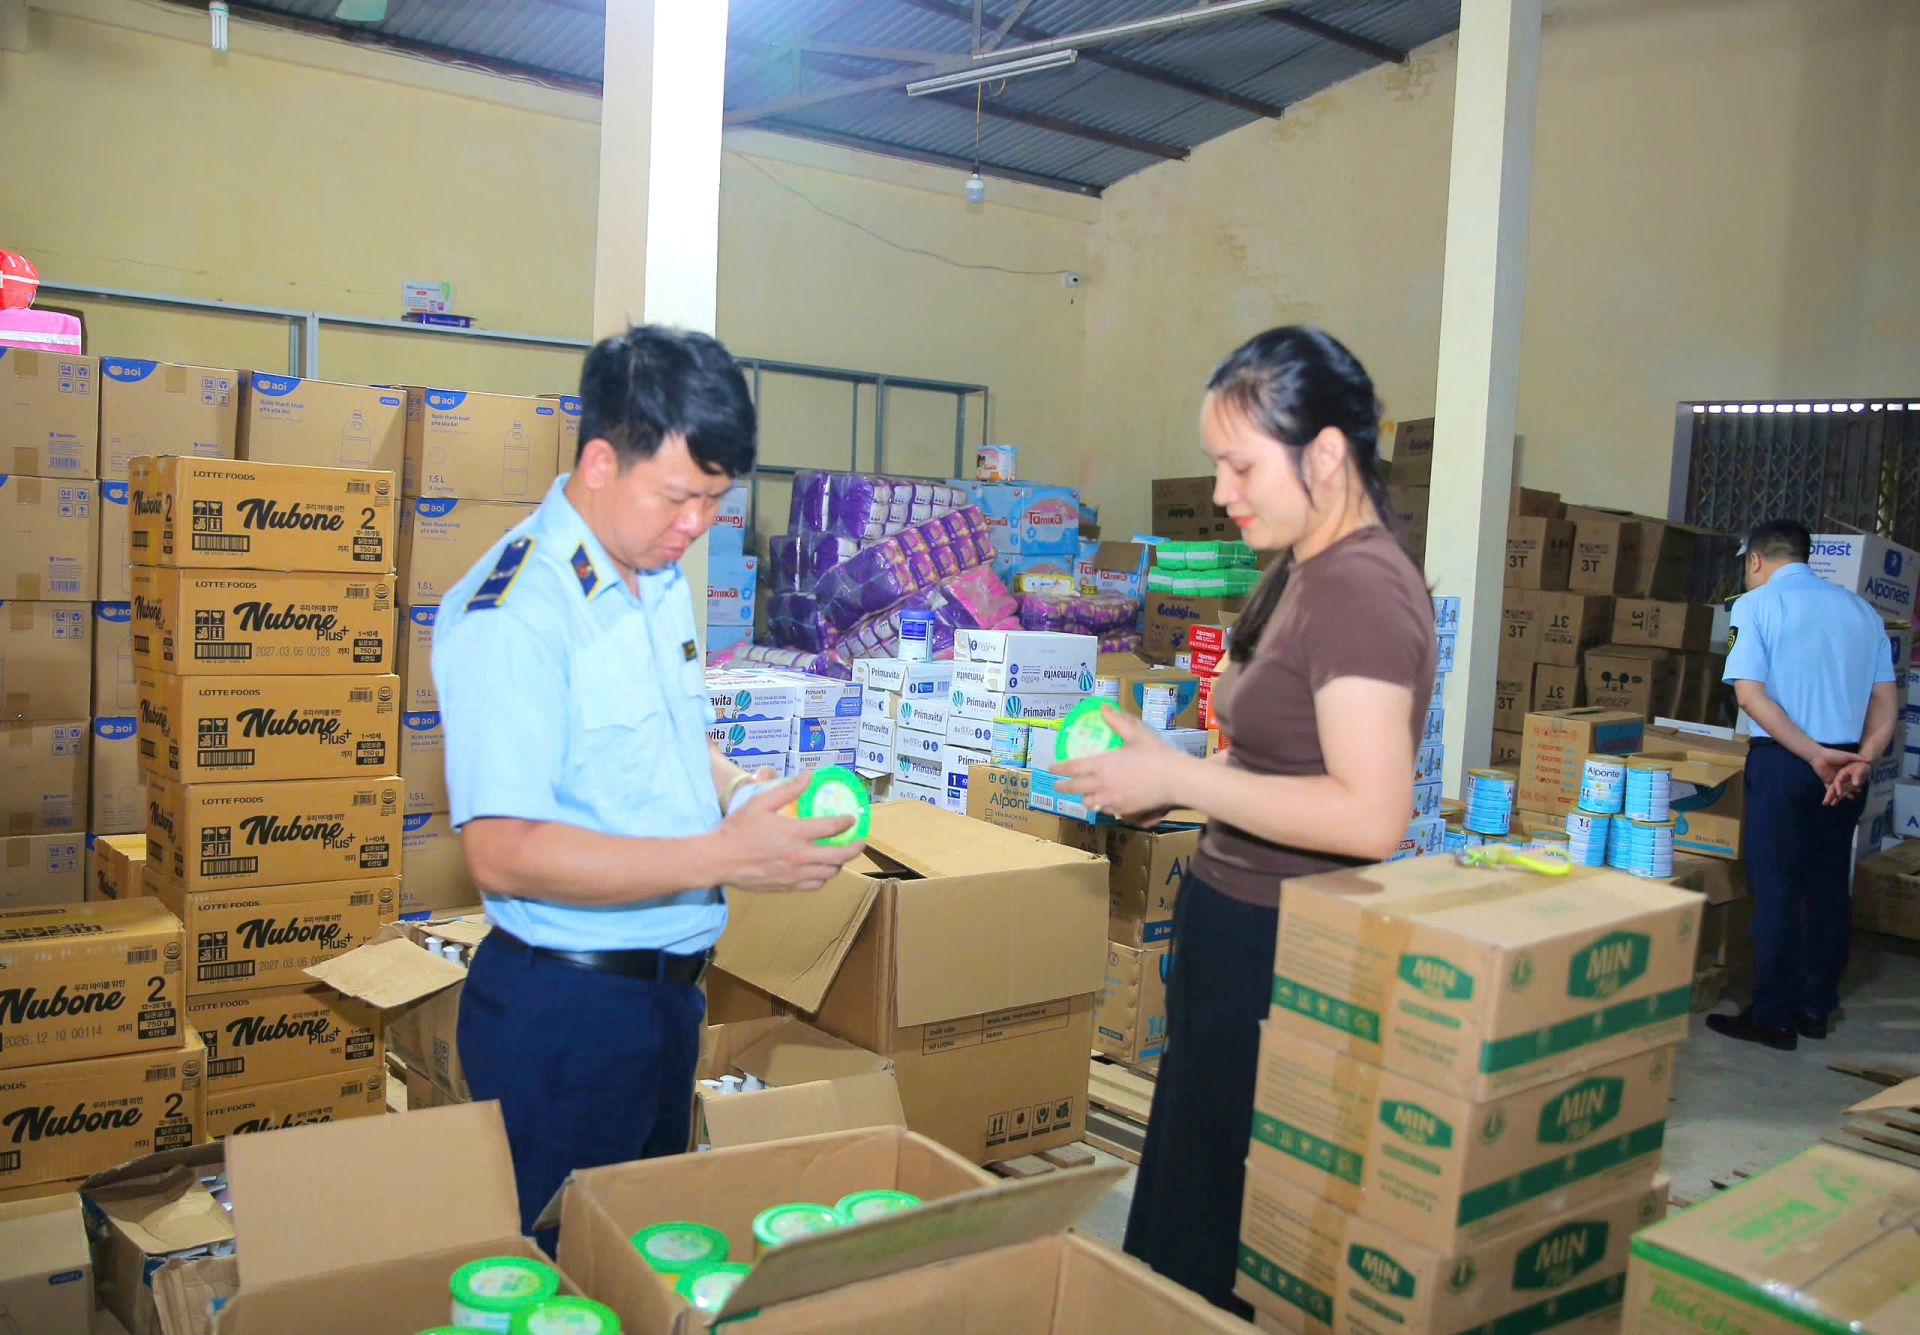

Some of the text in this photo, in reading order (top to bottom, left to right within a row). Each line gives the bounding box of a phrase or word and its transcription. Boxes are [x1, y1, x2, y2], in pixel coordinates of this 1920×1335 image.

[124, 365, 141, 377] aoi
[271, 381, 287, 391] aoi
[441, 395, 455, 405] aoi
[193, 470, 256, 481] LOTTE FOODS
[165, 494, 172, 522] 2
[236, 498, 344, 531] Nubone
[430, 504, 445, 513] aoi
[360, 507, 375, 530] 2
[1809, 543, 1852, 556] onest
[1509, 555, 1528, 568] 3T
[1581, 559, 1600, 573] 3T
[227, 581, 257, 589] FOODS
[1864, 575, 1910, 606] Alponest
[233, 601, 338, 632] Nubone
[1551, 614, 1570, 628] 3T
[1631, 610, 1644, 630] 3T
[316, 625, 350, 641] Plus+
[1508, 625, 1527, 638] 3T
[871, 667, 900, 680] Primavita
[1043, 669, 1077, 681] Primavita
[805, 689, 827, 697] Primavita
[1546, 685, 1565, 698] 3T
[966, 696, 997, 710] Primavita
[1497, 697, 1515, 710] 3T
[913, 709, 943, 723] Primavita
[1023, 707, 1056, 718] Primavita
[236, 708, 341, 738] Nubone
[421, 715, 435, 725] aoi
[115, 723, 133, 733] aoi
[861, 721, 889, 735] Primavita
[319, 728, 352, 745] Plus+
[1537, 743, 1563, 752] Alponte
[1536, 754, 1561, 763] Alponte
[912, 762, 941, 777] Primavita
[1535, 765, 1561, 774] Alponte
[1587, 766, 1620, 779] Alponte
[202, 796, 264, 805] LOTTE FOODS
[990, 792, 1029, 811] Alpont
[239, 815, 344, 846] Nubone
[322, 832, 356, 850] Plus+
[198, 900, 260, 911] LOTTE FOODS
[236, 917, 341, 949] Nubone
[320, 932, 353, 950] Plus+
[1587, 939, 1633, 973] MIN
[1414, 958, 1457, 988] MIN
[147, 975, 166, 1002] 2
[0, 985, 126, 1025] Nubone
[188, 999, 250, 1012] LOTTE FOODS
[146, 1019, 161, 1027] 750
[226, 1014, 330, 1047] Nubone
[308, 1026, 341, 1045] Plus+
[164, 1092, 184, 1119] 2
[227, 1101, 256, 1113] FOODS
[1557, 1086, 1606, 1123] MIN
[2, 1102, 143, 1144] Nubone
[1394, 1104, 1437, 1135] MIN
[164, 1135, 178, 1144] 750
[1536, 1229, 1589, 1272] MIN
[1361, 1250, 1399, 1284] MIN
